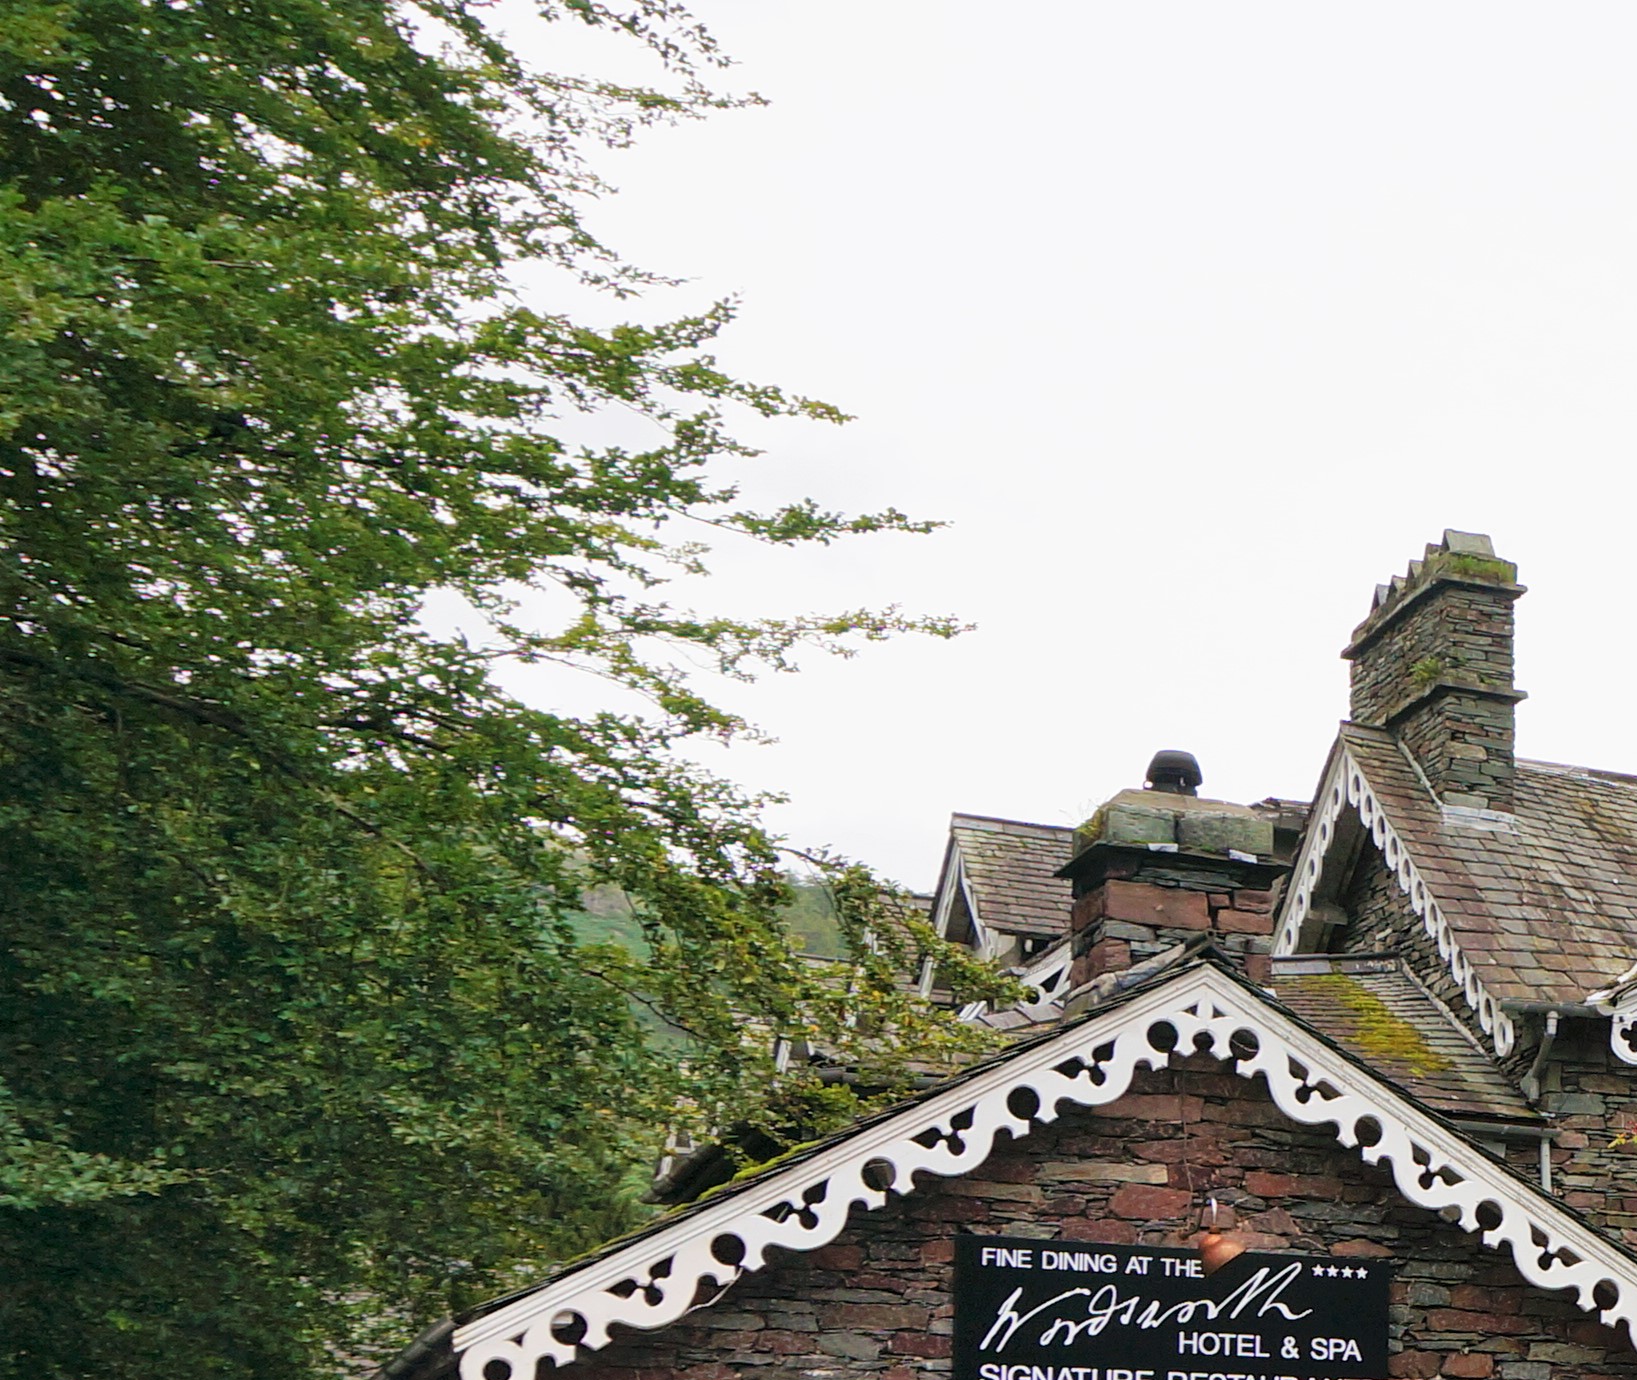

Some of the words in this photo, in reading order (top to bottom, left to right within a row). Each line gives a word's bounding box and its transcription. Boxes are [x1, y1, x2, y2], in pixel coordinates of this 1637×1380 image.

[981, 1247, 1032, 1268] FINE
[1041, 1251, 1118, 1274] DINING
[1125, 1256, 1152, 1275] AT
[1160, 1257, 1206, 1278] THE
[979, 1261, 1313, 1353] Wordsworth
[1178, 1331, 1270, 1358] HOTEL
[1280, 1336, 1300, 1360] &
[1310, 1337, 1363, 1362] SPA
